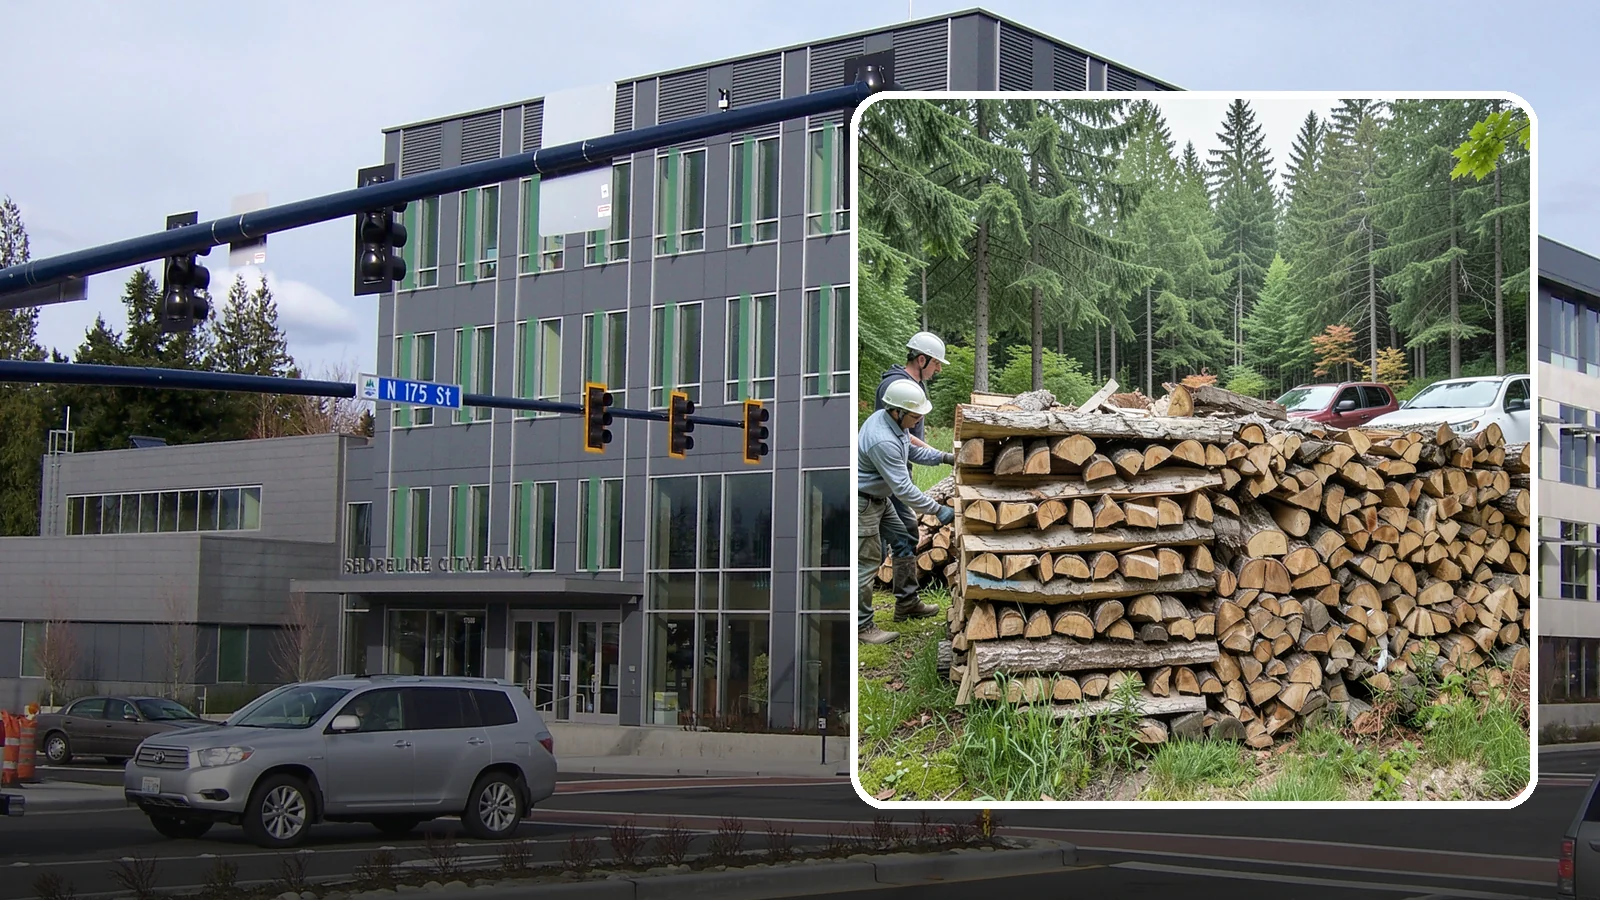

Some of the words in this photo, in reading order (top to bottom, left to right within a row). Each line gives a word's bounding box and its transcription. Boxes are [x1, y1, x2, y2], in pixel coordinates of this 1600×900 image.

[387, 380, 396, 400] N
[405, 383, 427, 403] 175
[436, 386, 451, 405] St
[344, 557, 432, 574] SHORELINE
[438, 556, 476, 572] CITY
[484, 556, 525, 572] HALL
